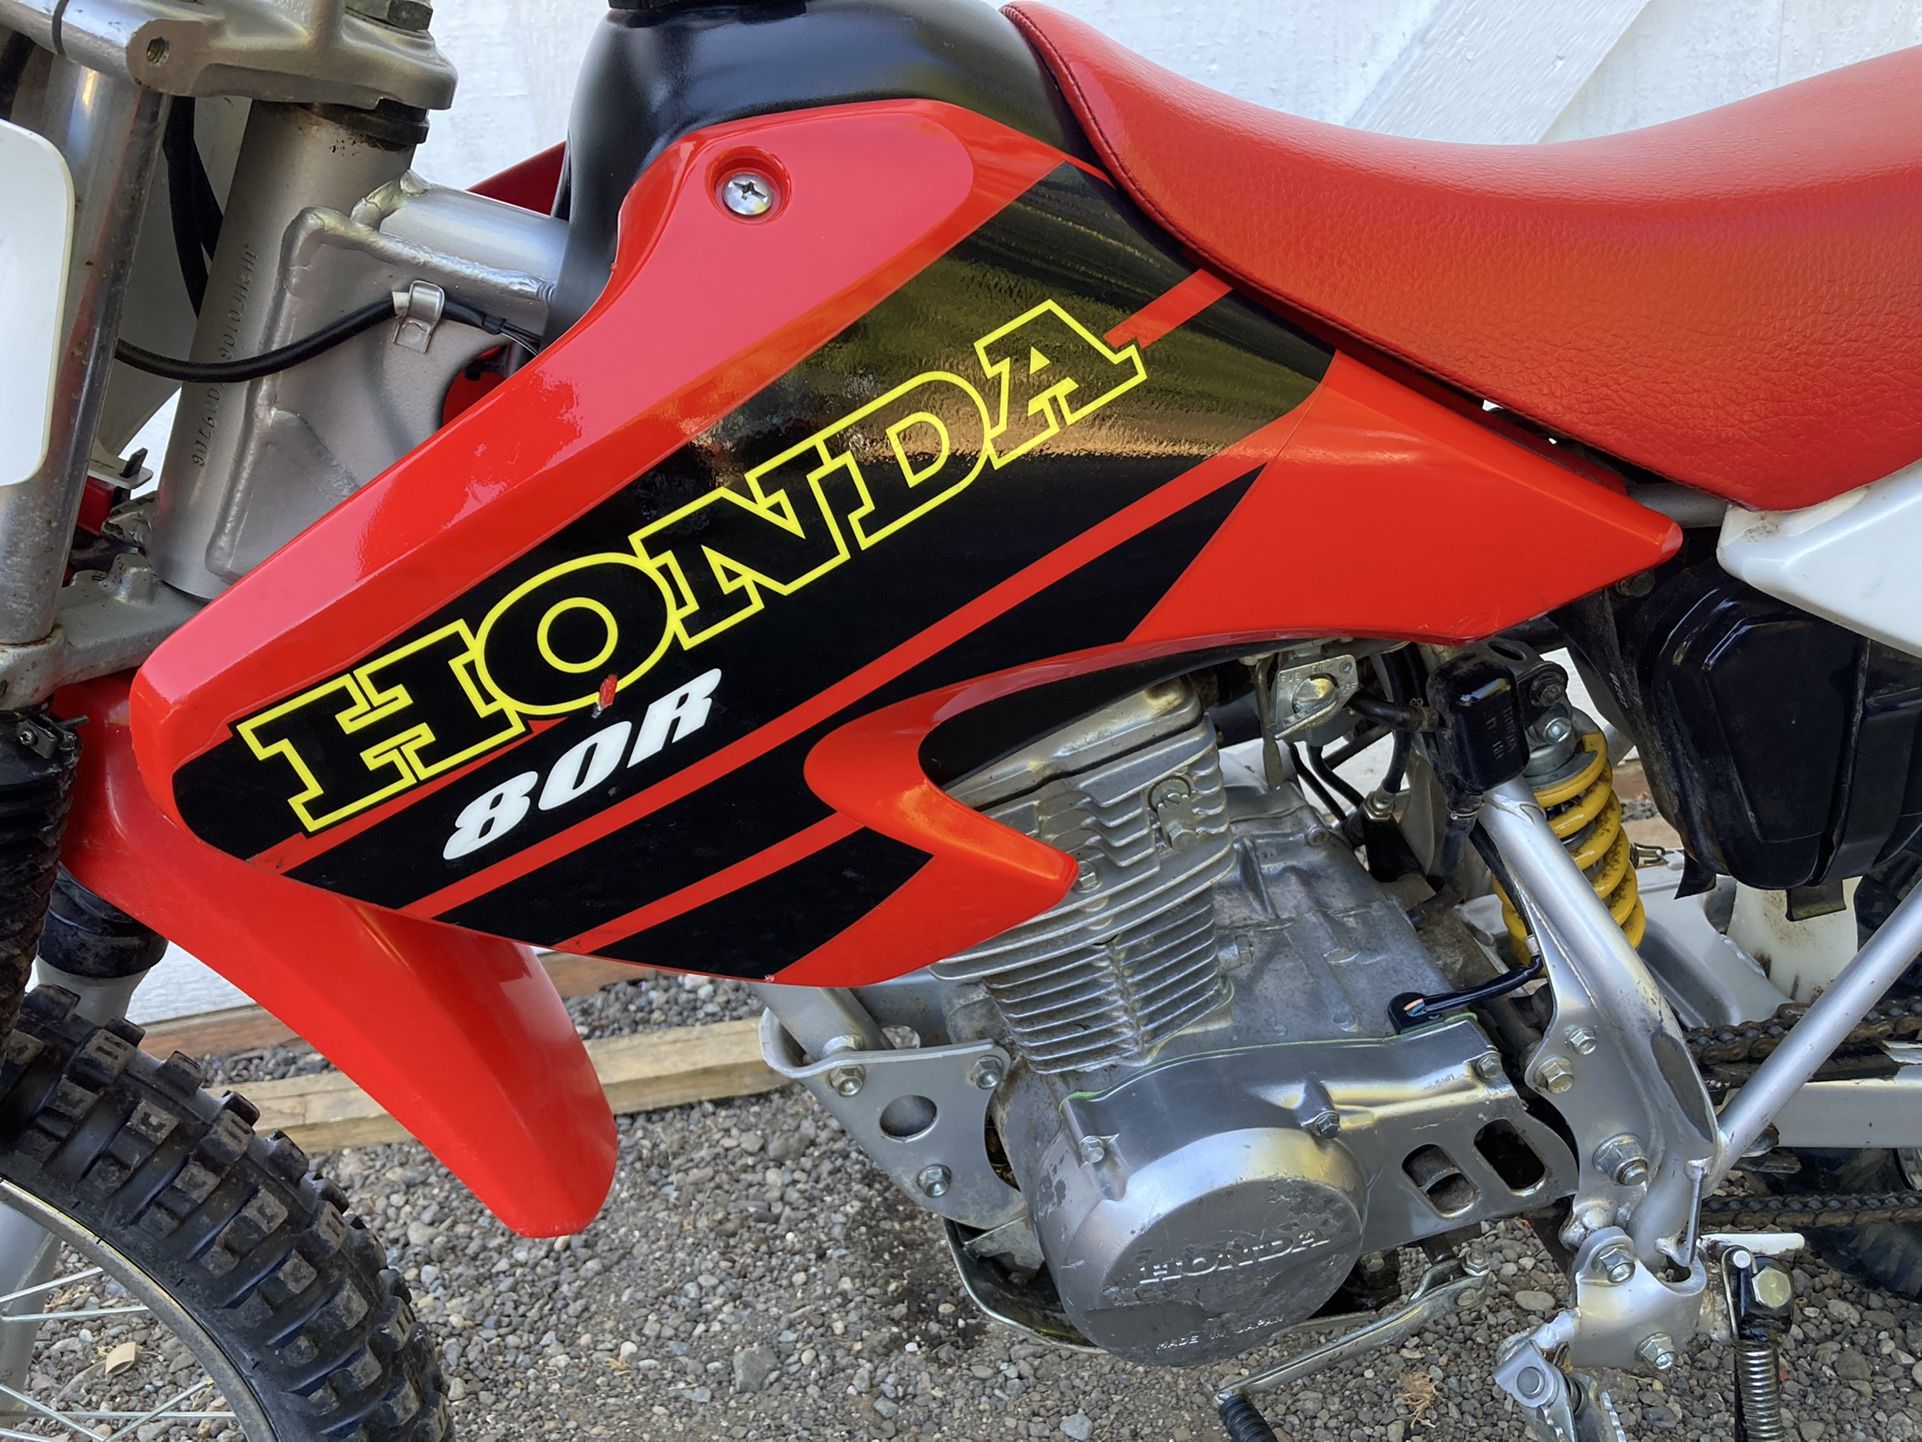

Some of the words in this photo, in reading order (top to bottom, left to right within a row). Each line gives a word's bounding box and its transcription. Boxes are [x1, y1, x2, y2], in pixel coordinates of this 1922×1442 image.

[236, 299, 1147, 833] HONDA
[443, 668, 722, 860] 80R
[1138, 1229, 1331, 1285] HONDA
[1155, 1334, 1199, 1354] MADE
